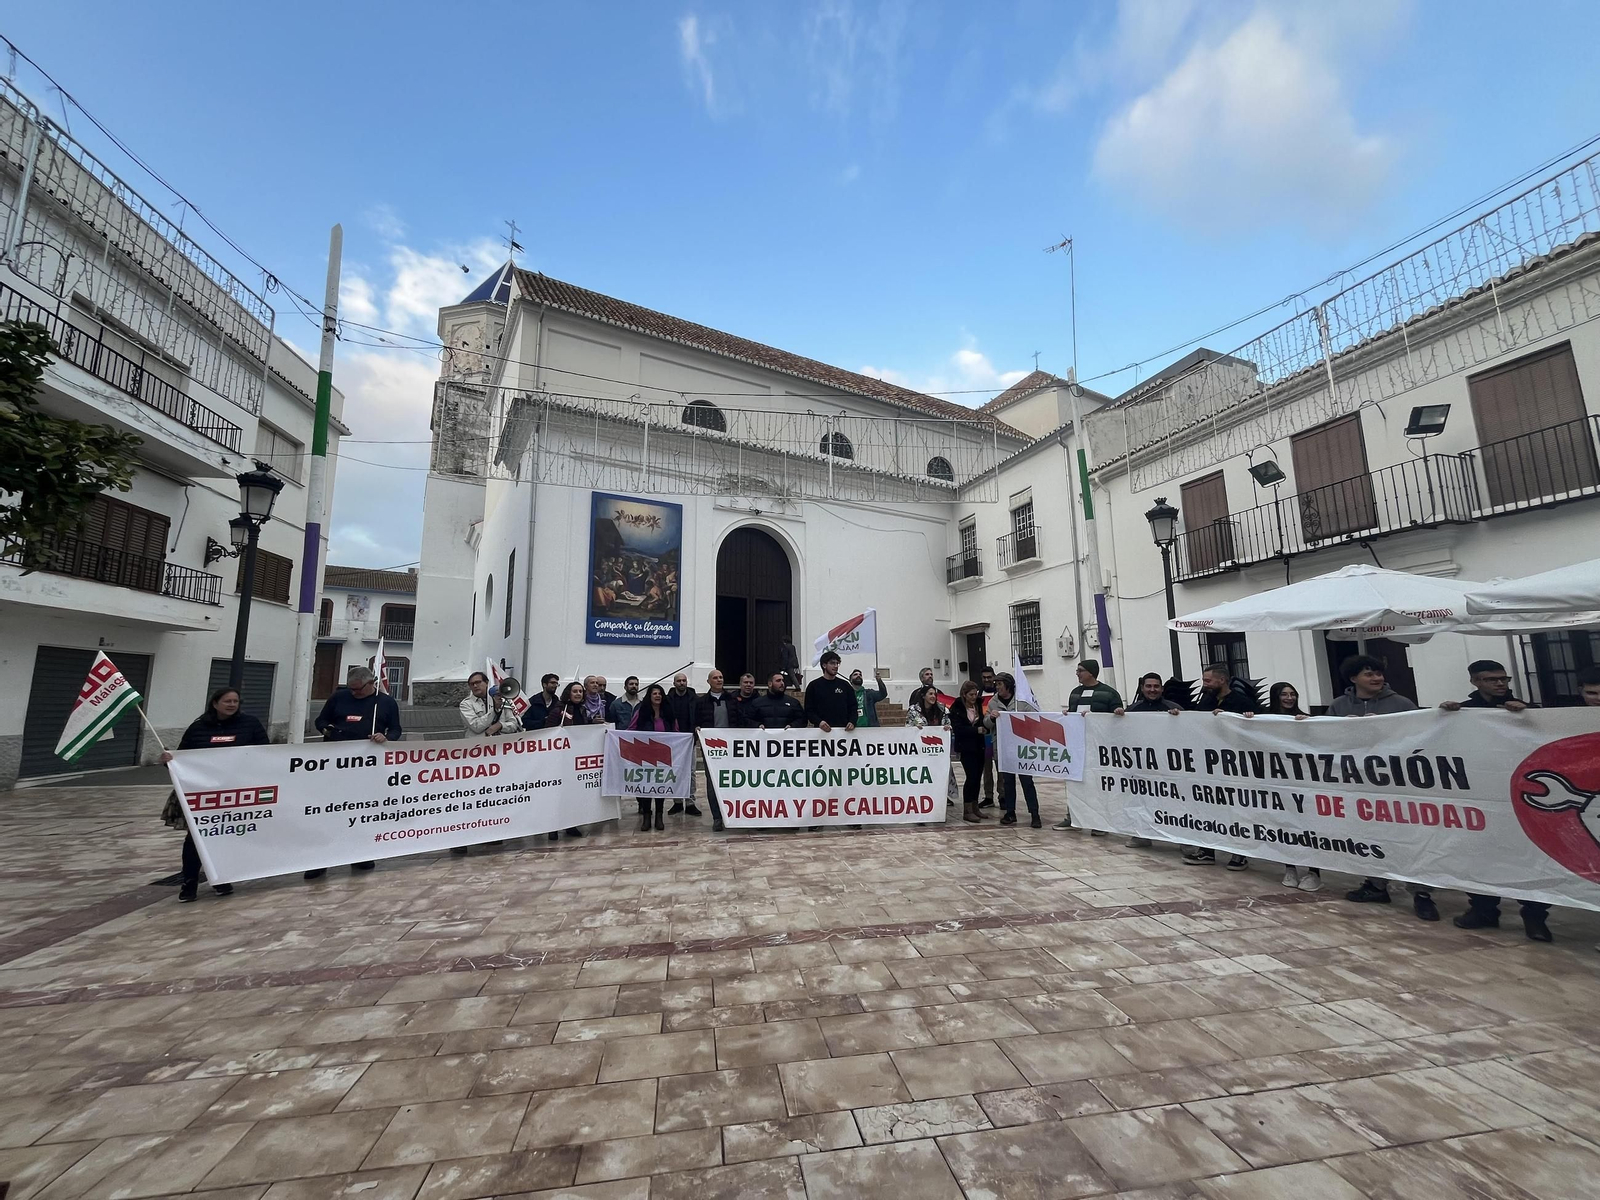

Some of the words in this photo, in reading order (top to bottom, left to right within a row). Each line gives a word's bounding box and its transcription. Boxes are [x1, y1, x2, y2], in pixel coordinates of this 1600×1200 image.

[1401, 608, 1454, 619] Czcampo
[594, 620, 633, 631] Comparte
[643, 621, 674, 634] llegada
[89, 675, 127, 707] Málaga
[289, 757, 330, 773] Por
[336, 755, 377, 770] una
[384, 744, 497, 766] EDUCACIÓN
[502, 737, 571, 756] PÚBLICA
[732, 740, 760, 758] EN
[766, 739, 862, 758] DEFENSA
[866, 743, 885, 756] DE
[888, 743, 918, 756] UNA
[921, 746, 944, 754] USTEA
[1017, 745, 1071, 764] USTEA
[577, 756, 604, 768] CC
[1018, 761, 1070, 775] MÁLAGA
[1098, 745, 1159, 770] BASTA
[1166, 748, 1196, 773] DE
[1204, 749, 1471, 791] PRIVATIZACIÓN
[387, 772, 412, 787] de
[417, 763, 501, 784] CALIDAD
[585, 779, 602, 789] mál
[623, 768, 677, 783] USTEA
[719, 765, 842, 788] EDUCACIÓN
[847, 764, 933, 786] PÚBLICA
[304, 805, 321, 816] En
[325, 799, 379, 813] defensa
[382, 797, 399, 807] de
[401, 795, 419, 805] los
[422, 788, 476, 802] derechos
[479, 786, 493, 796] de
[495, 777, 562, 793] trabajadoras
[624, 784, 674, 794] MÁLAGA
[348, 816, 357, 828] y
[360, 804, 442, 824] trabajadores
[445, 804, 459, 813] de
[462, 802, 473, 811] la
[476, 795, 531, 809] Educación
[792, 799, 807, 818] Y
[812, 798, 839, 818] DE
[843, 795, 934, 816] CALIDAD
[1101, 776, 1115, 792] FP
[1120, 775, 1186, 801] PÚBLICA,
[1192, 784, 1285, 811] GRATUITA
[1291, 793, 1304, 814] Y
[1315, 794, 1346, 819] DE
[1356, 798, 1486, 831] CALIDAD
[193, 809, 273, 825] nseñanza
[374, 816, 510, 843] #CCOOpornuestrofuturo
[1154, 810, 1228, 836] Sindicato
[1229, 822, 1250, 839] de
[1253, 824, 1386, 859] Estudiantes
